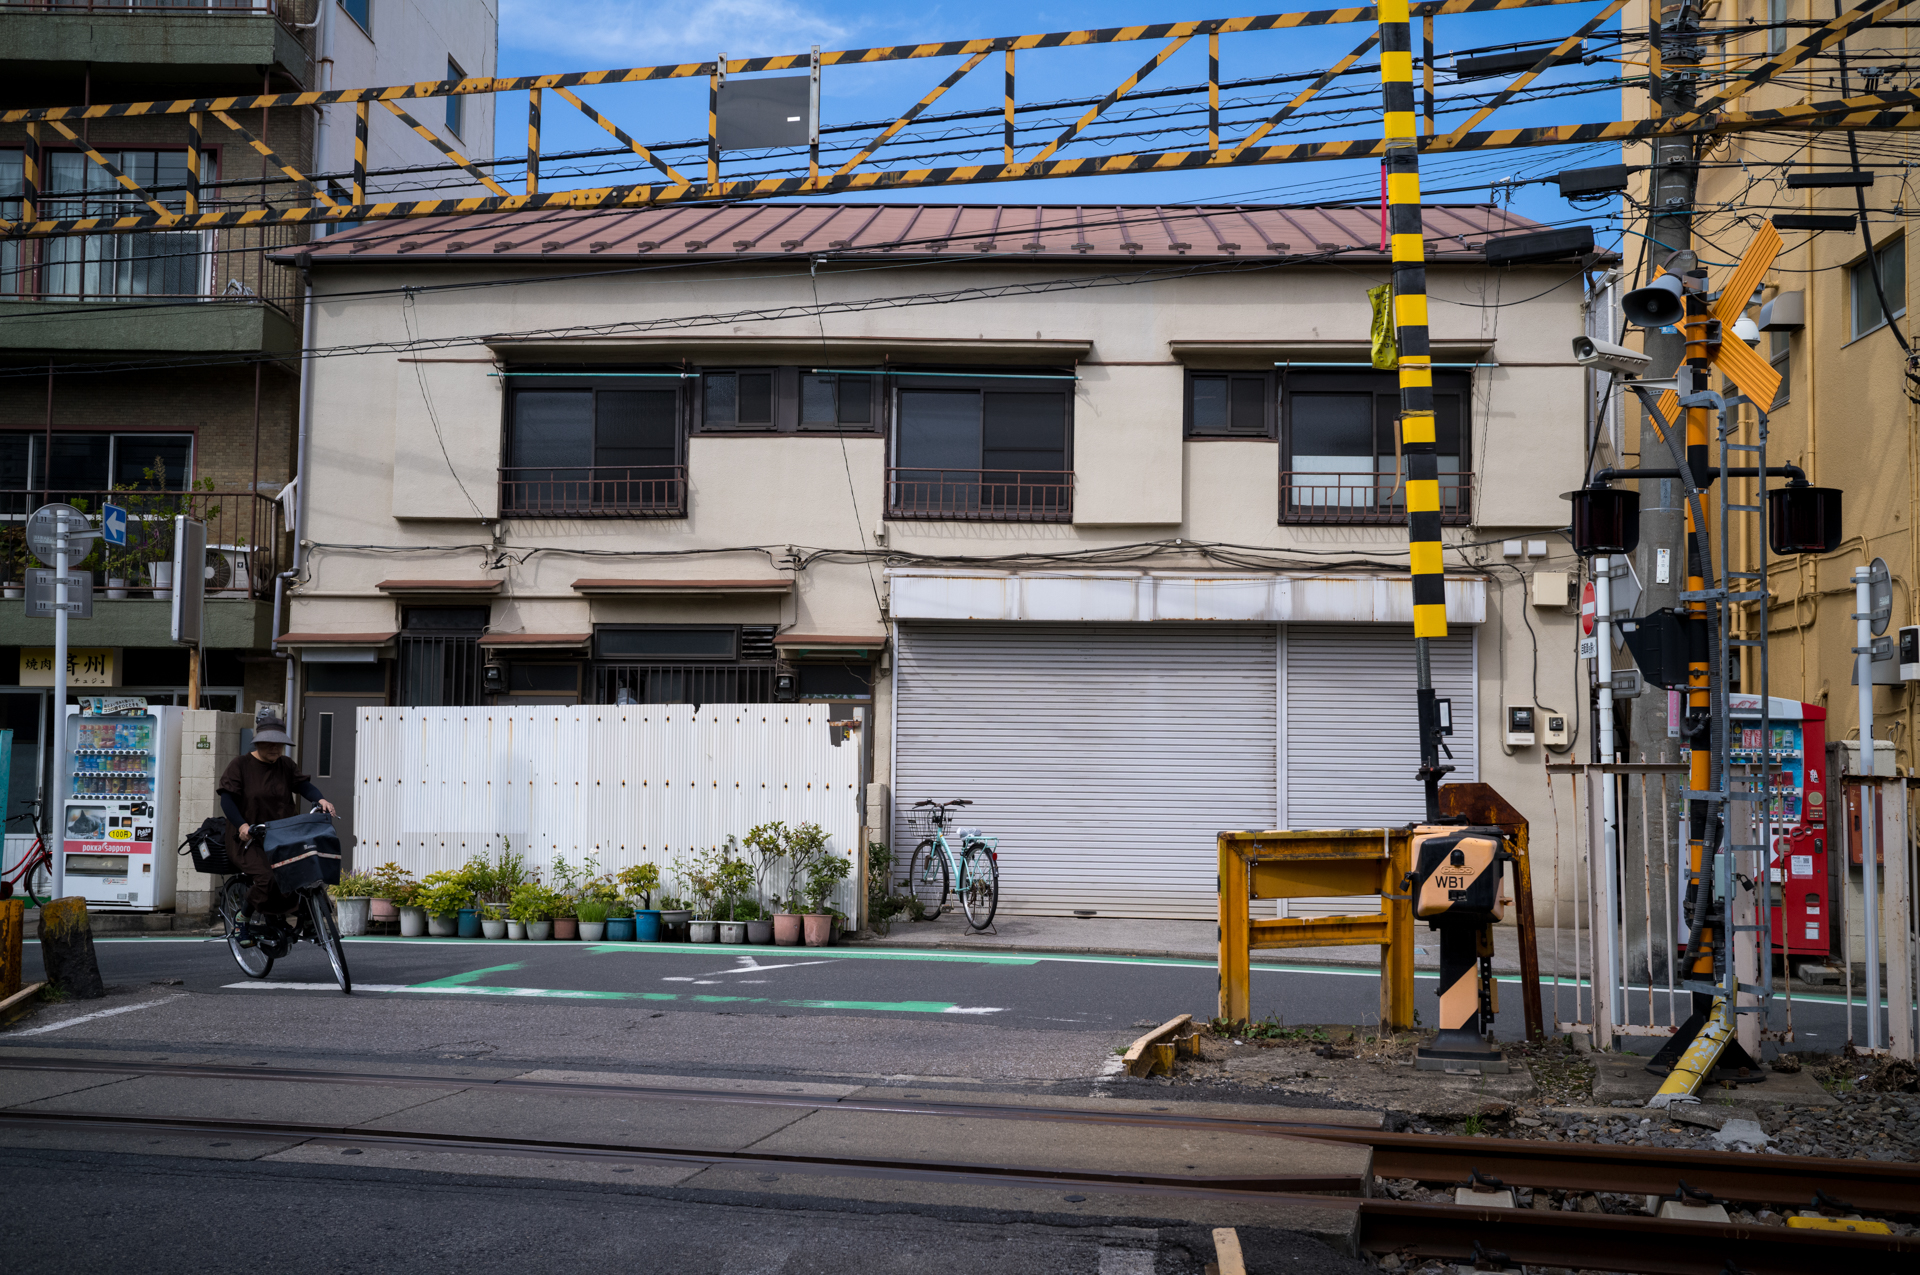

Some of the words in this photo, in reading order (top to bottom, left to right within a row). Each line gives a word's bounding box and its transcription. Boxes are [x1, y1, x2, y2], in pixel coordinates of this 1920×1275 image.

[25, 658, 52, 671] 焼肉
[112, 830, 129, 838] 100円
[1435, 876, 1463, 888] WB1
